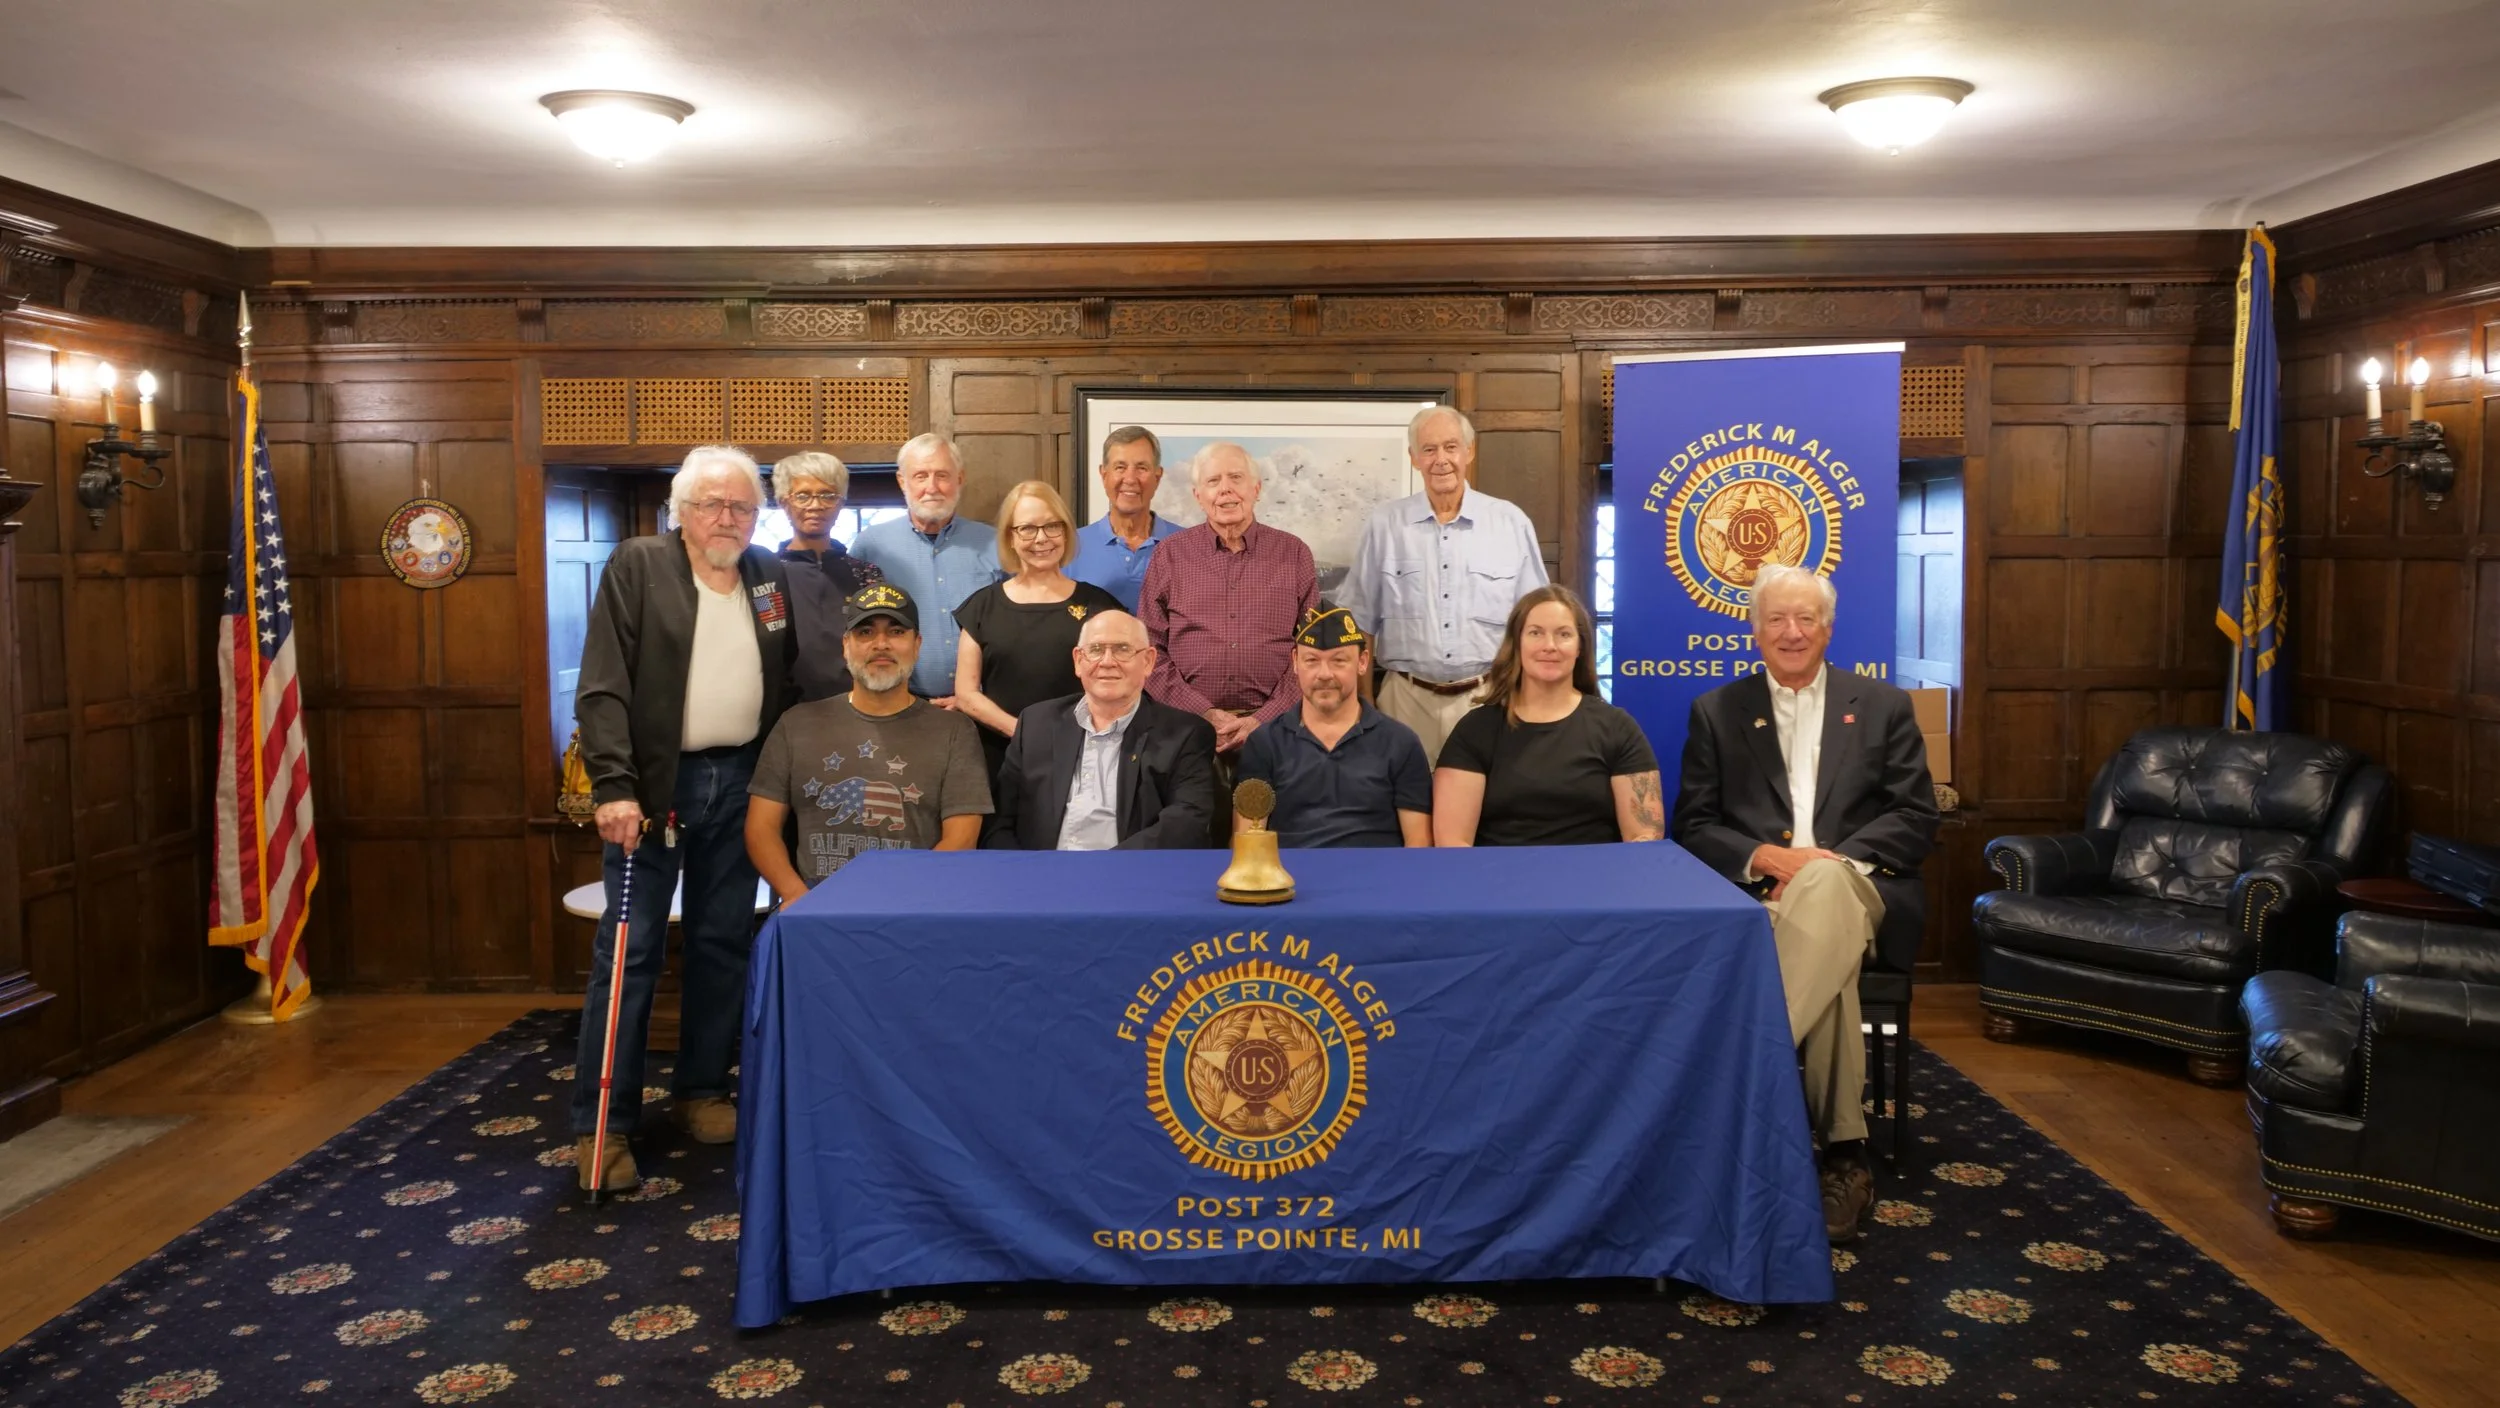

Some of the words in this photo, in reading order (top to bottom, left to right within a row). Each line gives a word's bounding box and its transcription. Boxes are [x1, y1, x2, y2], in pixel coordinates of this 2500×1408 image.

[1643, 423, 1763, 513] FREDERICK
[1772, 425, 1796, 445] M
[1801, 438, 1865, 511] ALGER
[1688, 464, 1821, 516] AMERICAN
[879, 586, 904, 600] NAVY
[1703, 576, 1750, 604] LEG
[1687, 634, 1755, 651] POST
[1620, 660, 1724, 677] GROSSE
[1855, 662, 1887, 679] MI
[1116, 930, 1270, 1042] FREDERICK
[1280, 935, 1310, 960] M
[1317, 952, 1396, 1042] ALGER
[1174, 982, 1342, 1048] AMERICAN
[1195, 1123, 1319, 1159] LEGION
[1177, 1196, 1264, 1218] POST
[1276, 1196, 1335, 1218] 372
[1092, 1228, 1224, 1251] GROSSE
[1237, 1227, 1369, 1252] POINTE,
[1382, 1227, 1421, 1250] MI
